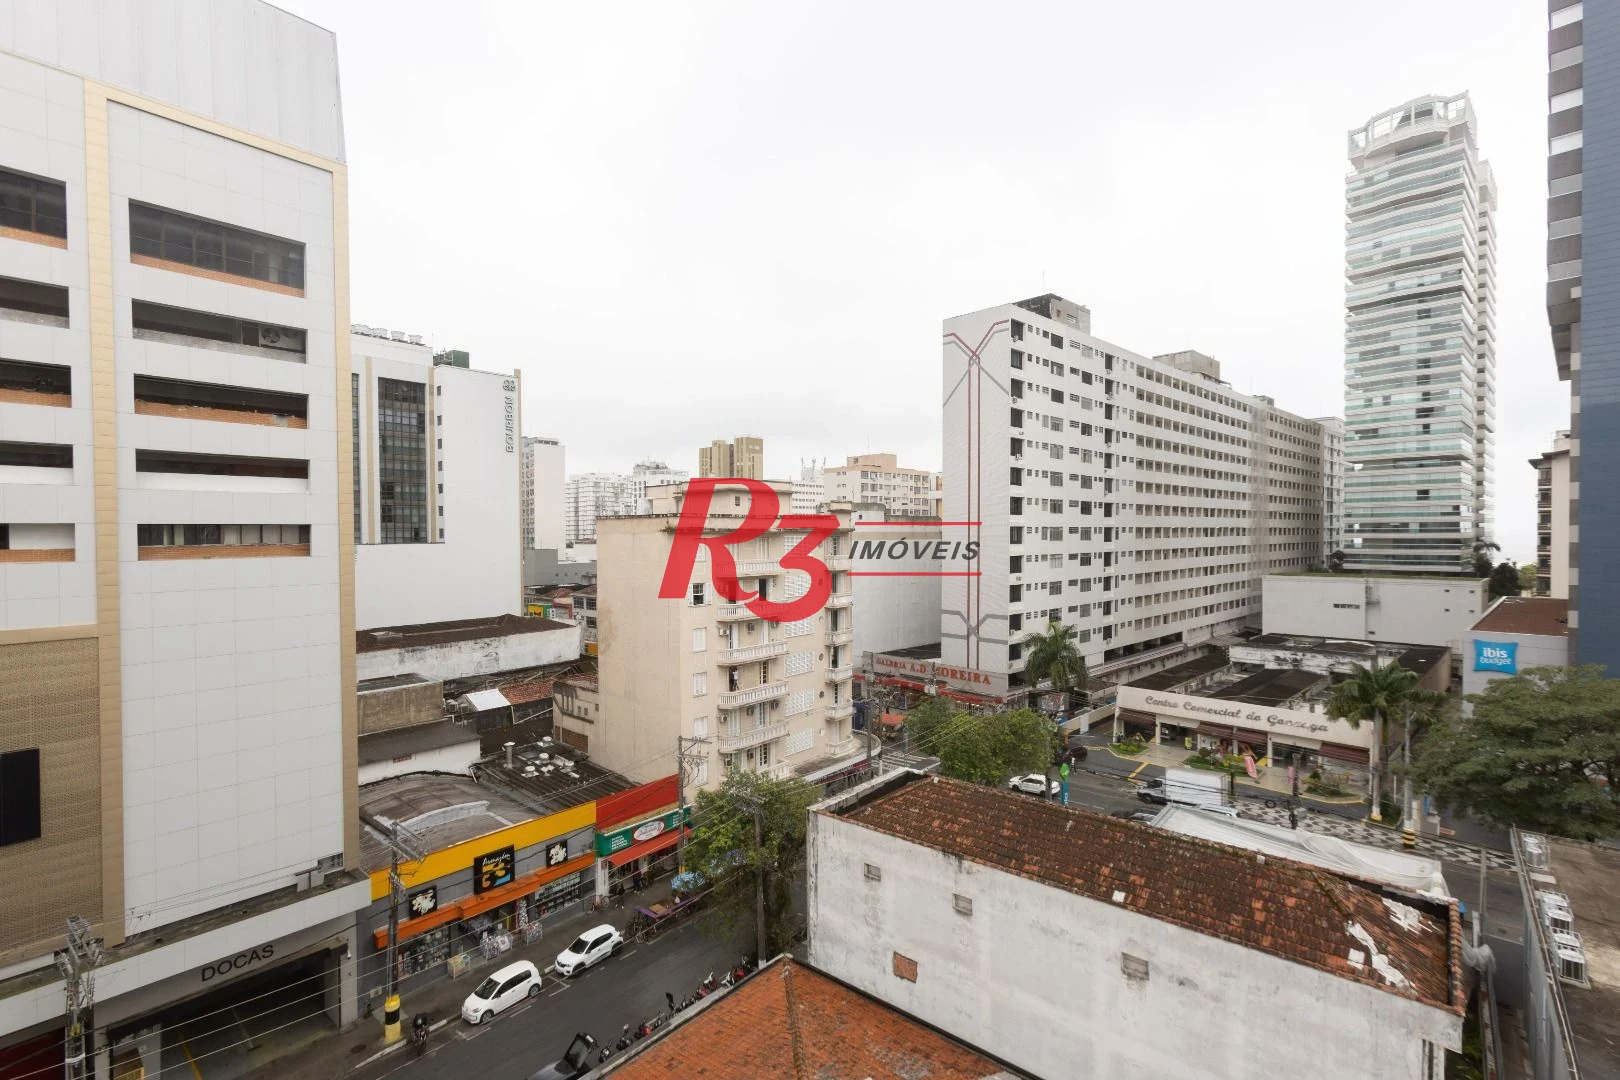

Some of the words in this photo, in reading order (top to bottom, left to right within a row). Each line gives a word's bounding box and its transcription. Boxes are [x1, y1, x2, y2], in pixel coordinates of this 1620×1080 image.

[504, 396, 514, 453] BOURBON
[1480, 657, 1512, 666] budget
[1483, 647, 1508, 658] ibis
[1145, 696, 1178, 709] Centro
[1183, 702, 1241, 719] Comercial
[1246, 710, 1261, 721] do
[201, 944, 275, 982] DOCAS
